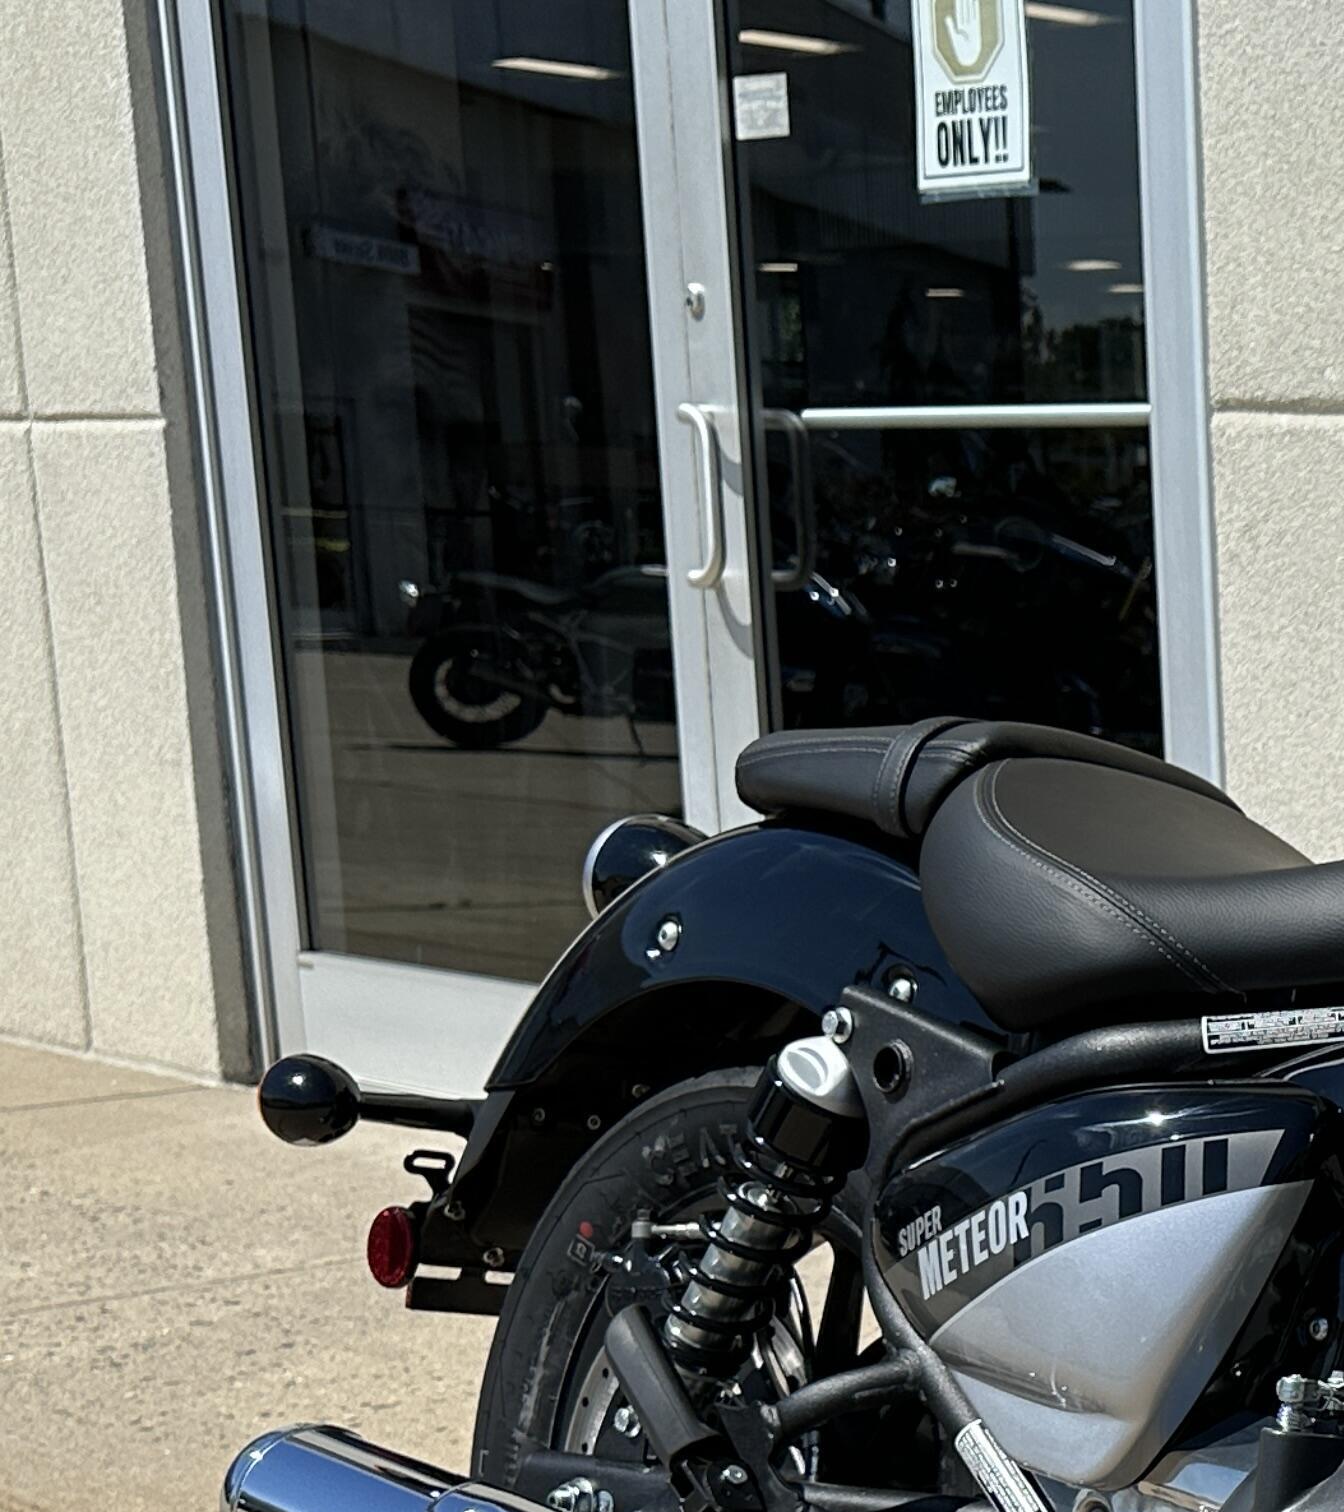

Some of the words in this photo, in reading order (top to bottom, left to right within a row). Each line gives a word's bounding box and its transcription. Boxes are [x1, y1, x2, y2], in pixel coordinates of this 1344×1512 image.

[934, 84, 1008, 117] EMPLOYEES
[937, 115, 1008, 168] ONLY!!
[898, 1205, 943, 1257] SUPER
[917, 1191, 1030, 1301] METEOR
